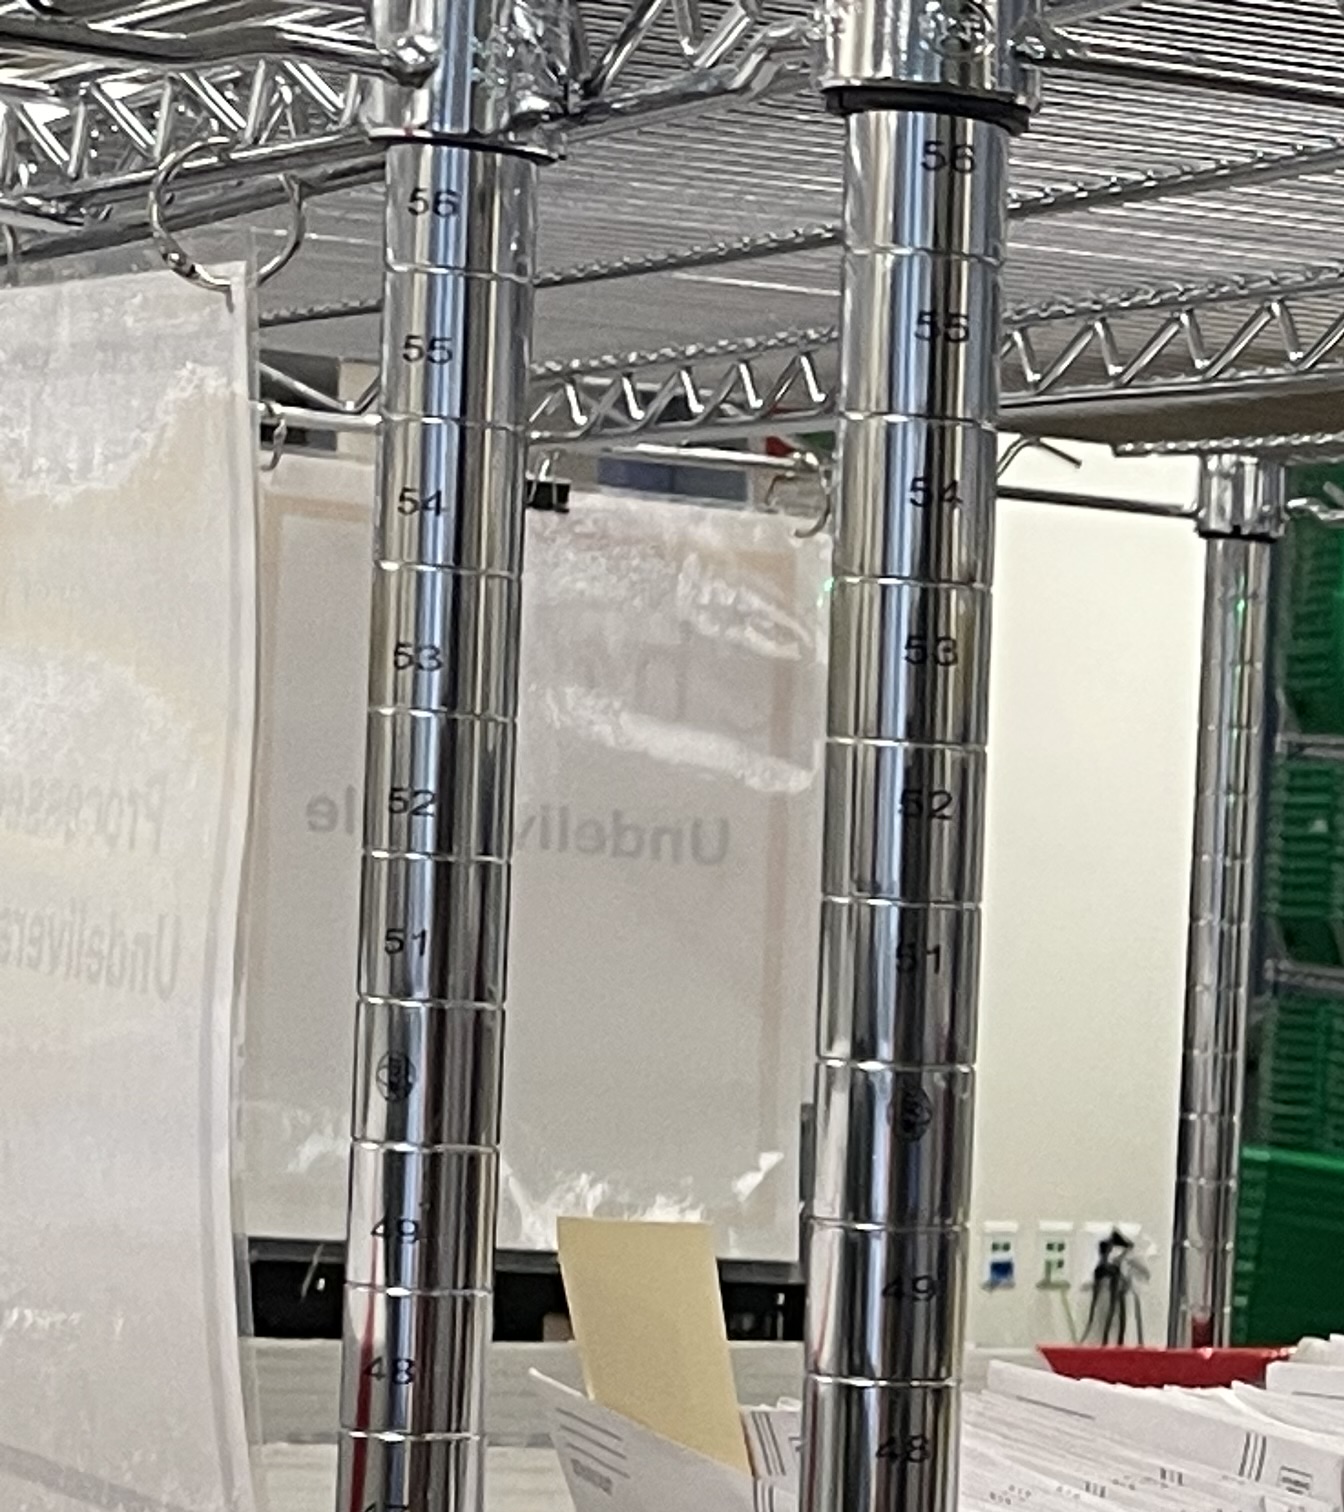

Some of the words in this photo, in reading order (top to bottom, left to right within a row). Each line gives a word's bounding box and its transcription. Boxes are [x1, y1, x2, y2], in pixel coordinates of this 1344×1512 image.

[921, 141, 977, 173] 56
[408, 190, 462, 217] 56
[915, 313, 970, 343] 55
[402, 335, 453, 365] 55
[397, 488, 446, 517] 54
[392, 643, 445, 673] 53
[903, 635, 960, 669] 53
[387, 786, 437, 817] 52
[898, 790, 955, 822] 52
[383, 928, 430, 957] 51
[895, 942, 943, 976] 51
[370, 1217, 421, 1244] 49
[880, 1273, 938, 1305] 49
[362, 1357, 418, 1385] 48
